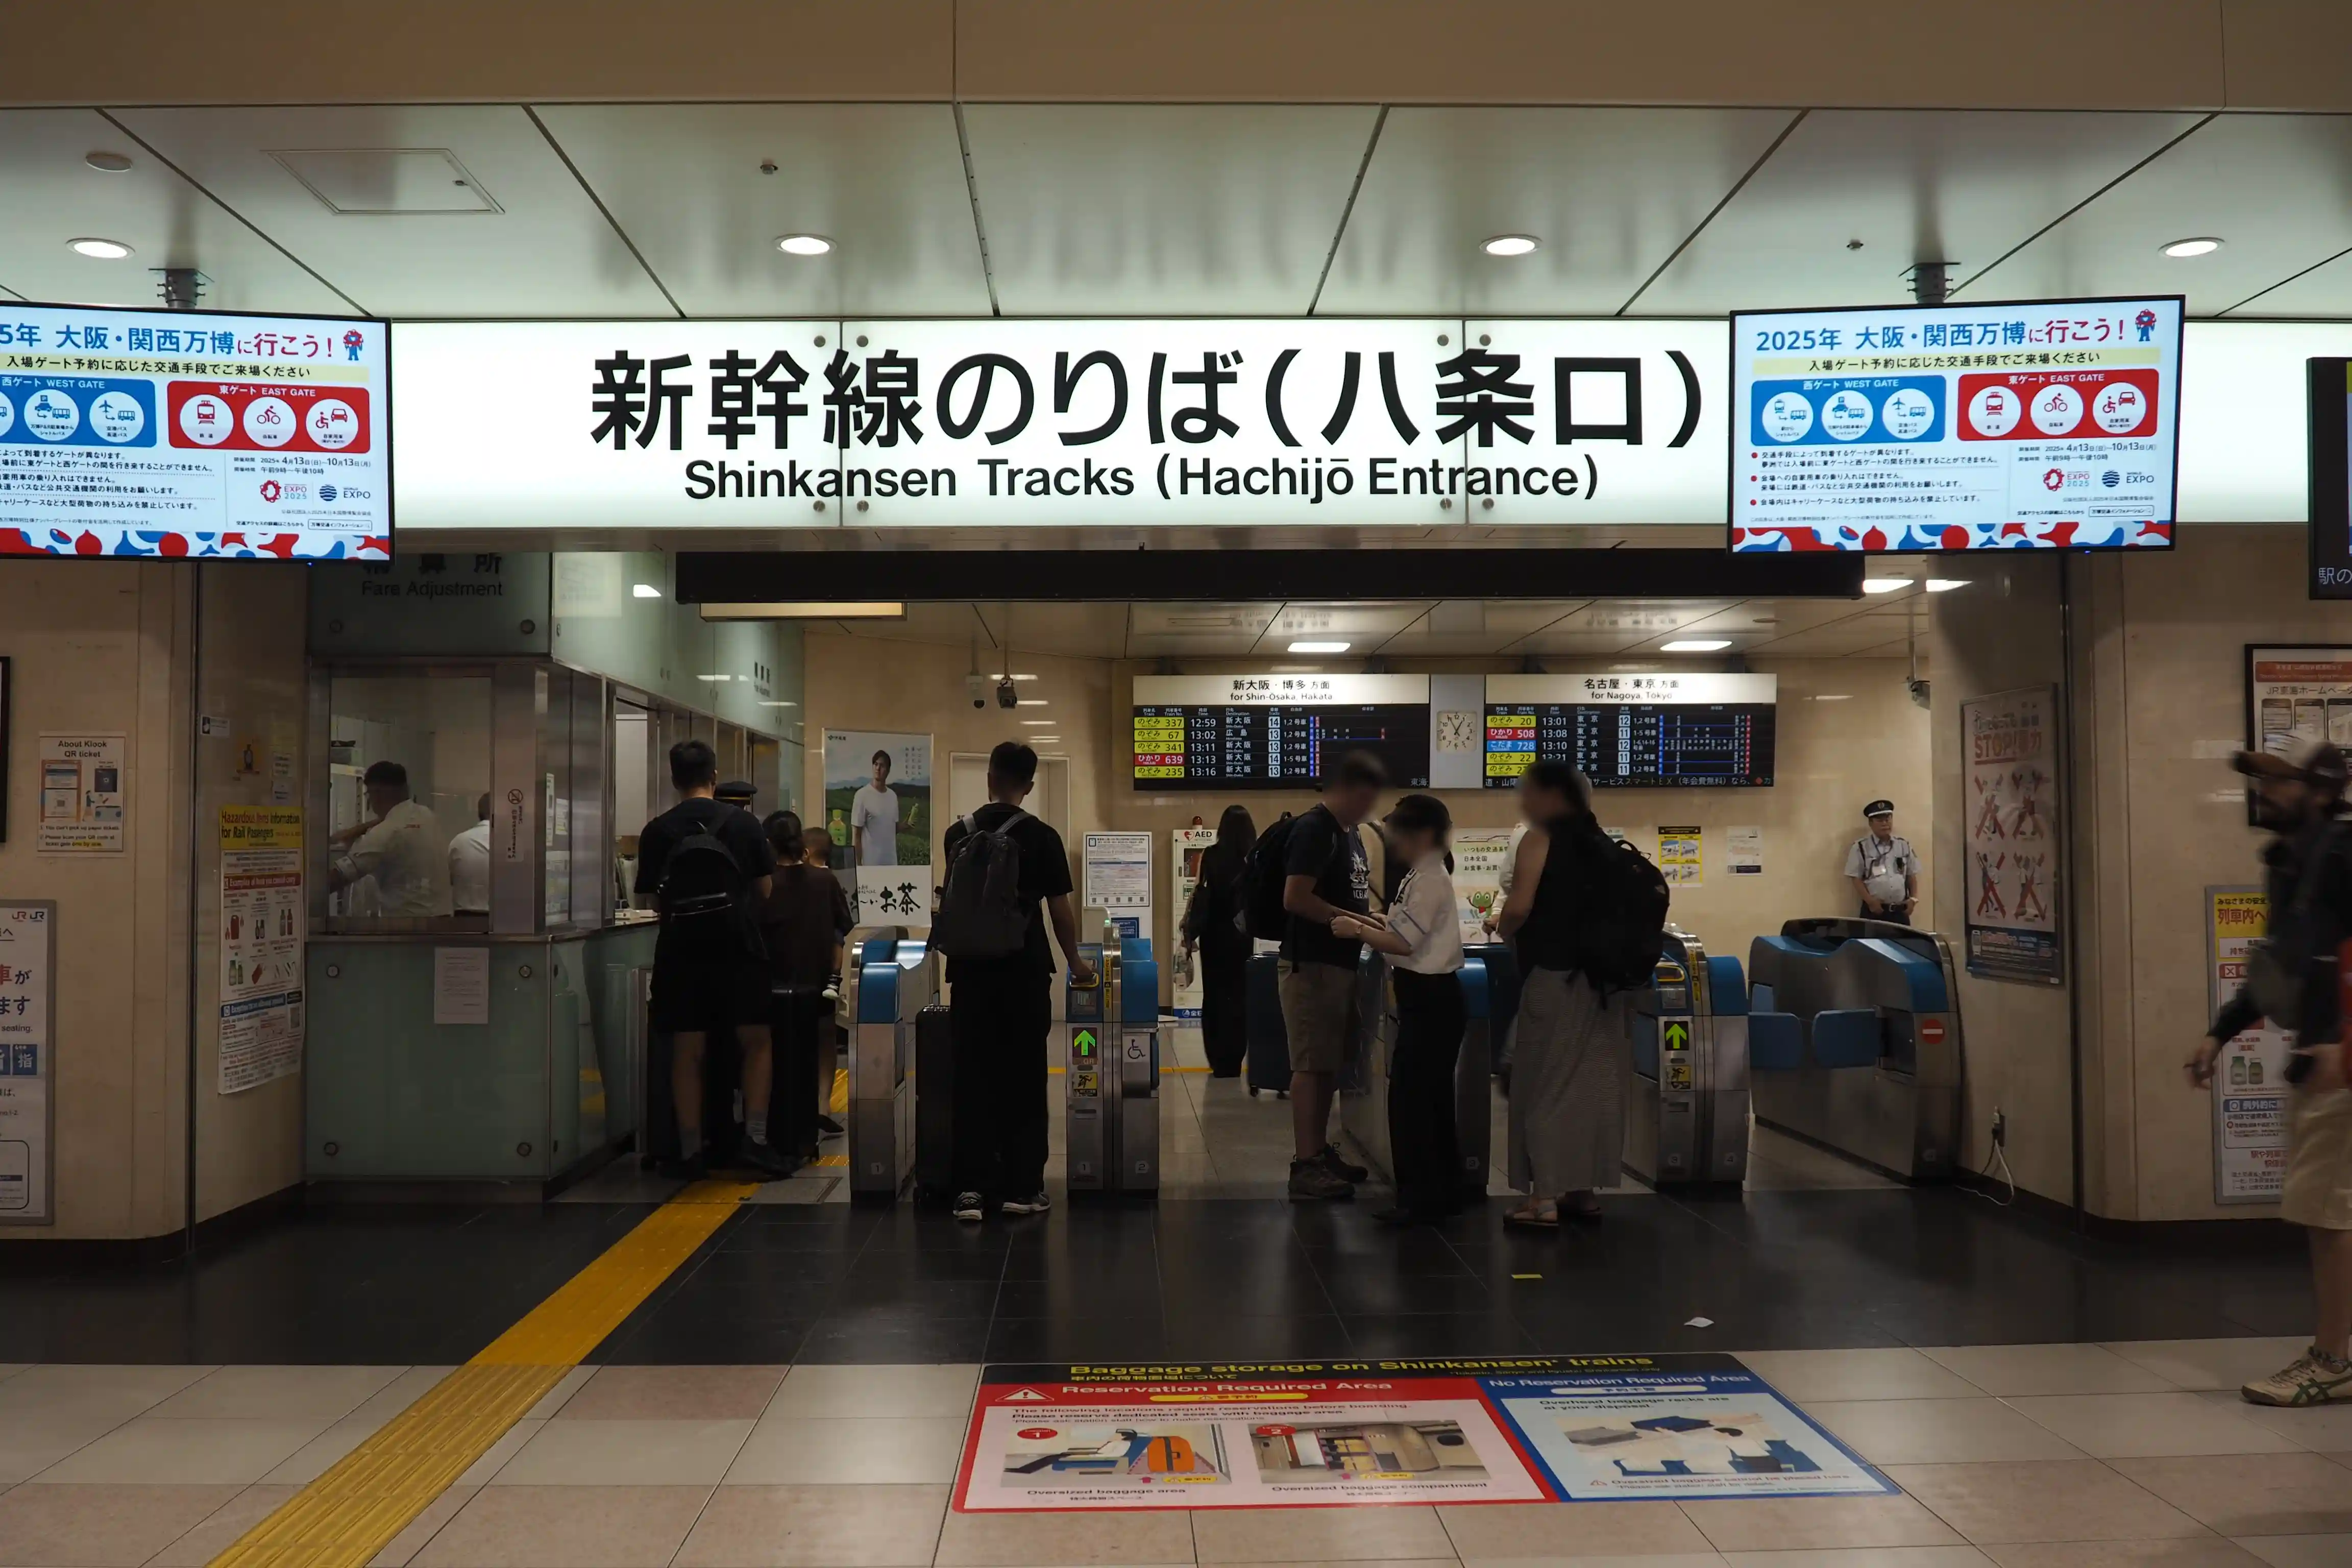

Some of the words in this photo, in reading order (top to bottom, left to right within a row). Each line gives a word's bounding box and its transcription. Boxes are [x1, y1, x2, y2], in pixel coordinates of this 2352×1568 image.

[1756, 328, 1842, 351] 2025年
[7, 355, 311, 377] 入場ゲート予約に応じた交通手段でご来場ください
[1808, 352, 2100, 372] 入場ゲート予約に応じた交通手段でご来場ください
[2, 376, 42, 387] 西ゲート
[46, 379, 75, 387] WEST
[79, 380, 105, 389] GATE
[1803, 380, 1840, 390] 西ゲート
[1844, 380, 1871, 388] WEST
[1874, 379, 1900, 388] GATE
[2008, 375, 2045, 385] 東ゲート
[2050, 375, 2076, 383] EAST
[2078, 374, 2105, 382] GATE
[219, 385, 257, 396] 東ゲート
[262, 387, 288, 396] EAST
[290, 388, 316, 397] GATE
[591, 349, 1701, 450] 新幹線のりば（八条口）
[684, 459, 956, 499] Shinkansen
[977, 458, 1135, 497] Tracks
[1157, 453, 1354, 504] (Hachijō
[1369, 453, 1598, 499] Entrance)
[2126, 475, 2154, 483] EXPO
[344, 491, 371, 499] EXPO
[2318, 567, 2352, 585] 駅の
[362, 581, 400, 597] Fare
[406, 581, 503, 600] Adjustment
[1230, 693, 1243, 701] for
[1301, 692, 1333, 700] Hakata
[1165, 719, 1183, 727] 337
[1190, 718, 1216, 727] 12:59
[1269, 717, 1279, 726] 14
[1542, 717, 1566, 726] 13:01
[1620, 717, 1629, 725] 12
[1168, 731, 1180, 739] 67
[1190, 730, 1216, 740] 13:02
[1269, 730, 1279, 739] 13
[1517, 729, 1535, 738] 508
[1542, 729, 1567, 738] 13:08
[1620, 729, 1628, 738] 11
[1165, 743, 1182, 751] 341
[1190, 743, 1215, 752] 13:11
[1226, 741, 1251, 749] 新大阪
[1269, 742, 1279, 751] 13
[1517, 742, 1534, 750] 728
[1542, 741, 1567, 750] 13:10
[1620, 741, 1629, 750] 12
[1165, 755, 1183, 764] 639
[1190, 755, 1216, 764] 13:13
[1226, 753, 1251, 761] 新大阪
[1269, 754, 1279, 763] 14
[1620, 753, 1628, 762] 11
[1165, 768, 1183, 776] 235
[1190, 767, 1217, 776] 13:16
[1269, 767, 1279, 775] 13
[1620, 766, 1627, 774] 11
[222, 810, 256, 824] Hazardous
[270, 812, 300, 824] Information
[222, 825, 231, 838] for
[233, 825, 246, 838] Rail
[247, 826, 274, 842] Passengers
[12, 911, 27, 920] JR
[30, 911, 44, 920] JR
[2217, 908, 2271, 925] 列車内へ
[0, 928, 13, 937] へ
[2, 1024, 33, 1033] seating.
[18, 1052, 33, 1068] 指
[875, 1164, 880, 1173] 1
[1070, 1364, 1202, 1375] Baggage
[1211, 1363, 1323, 1372] storage
[1332, 1362, 1369, 1371] on
[1569, 1356, 1654, 1366] trains
[1521, 1378, 1623, 1386] Reservation
[1627, 1376, 1705, 1385] Required
[1710, 1374, 1751, 1382] Area
[1062, 1384, 1208, 1394] Reservation
[1217, 1382, 1327, 1393] Required
[1336, 1382, 1392, 1390] Area
